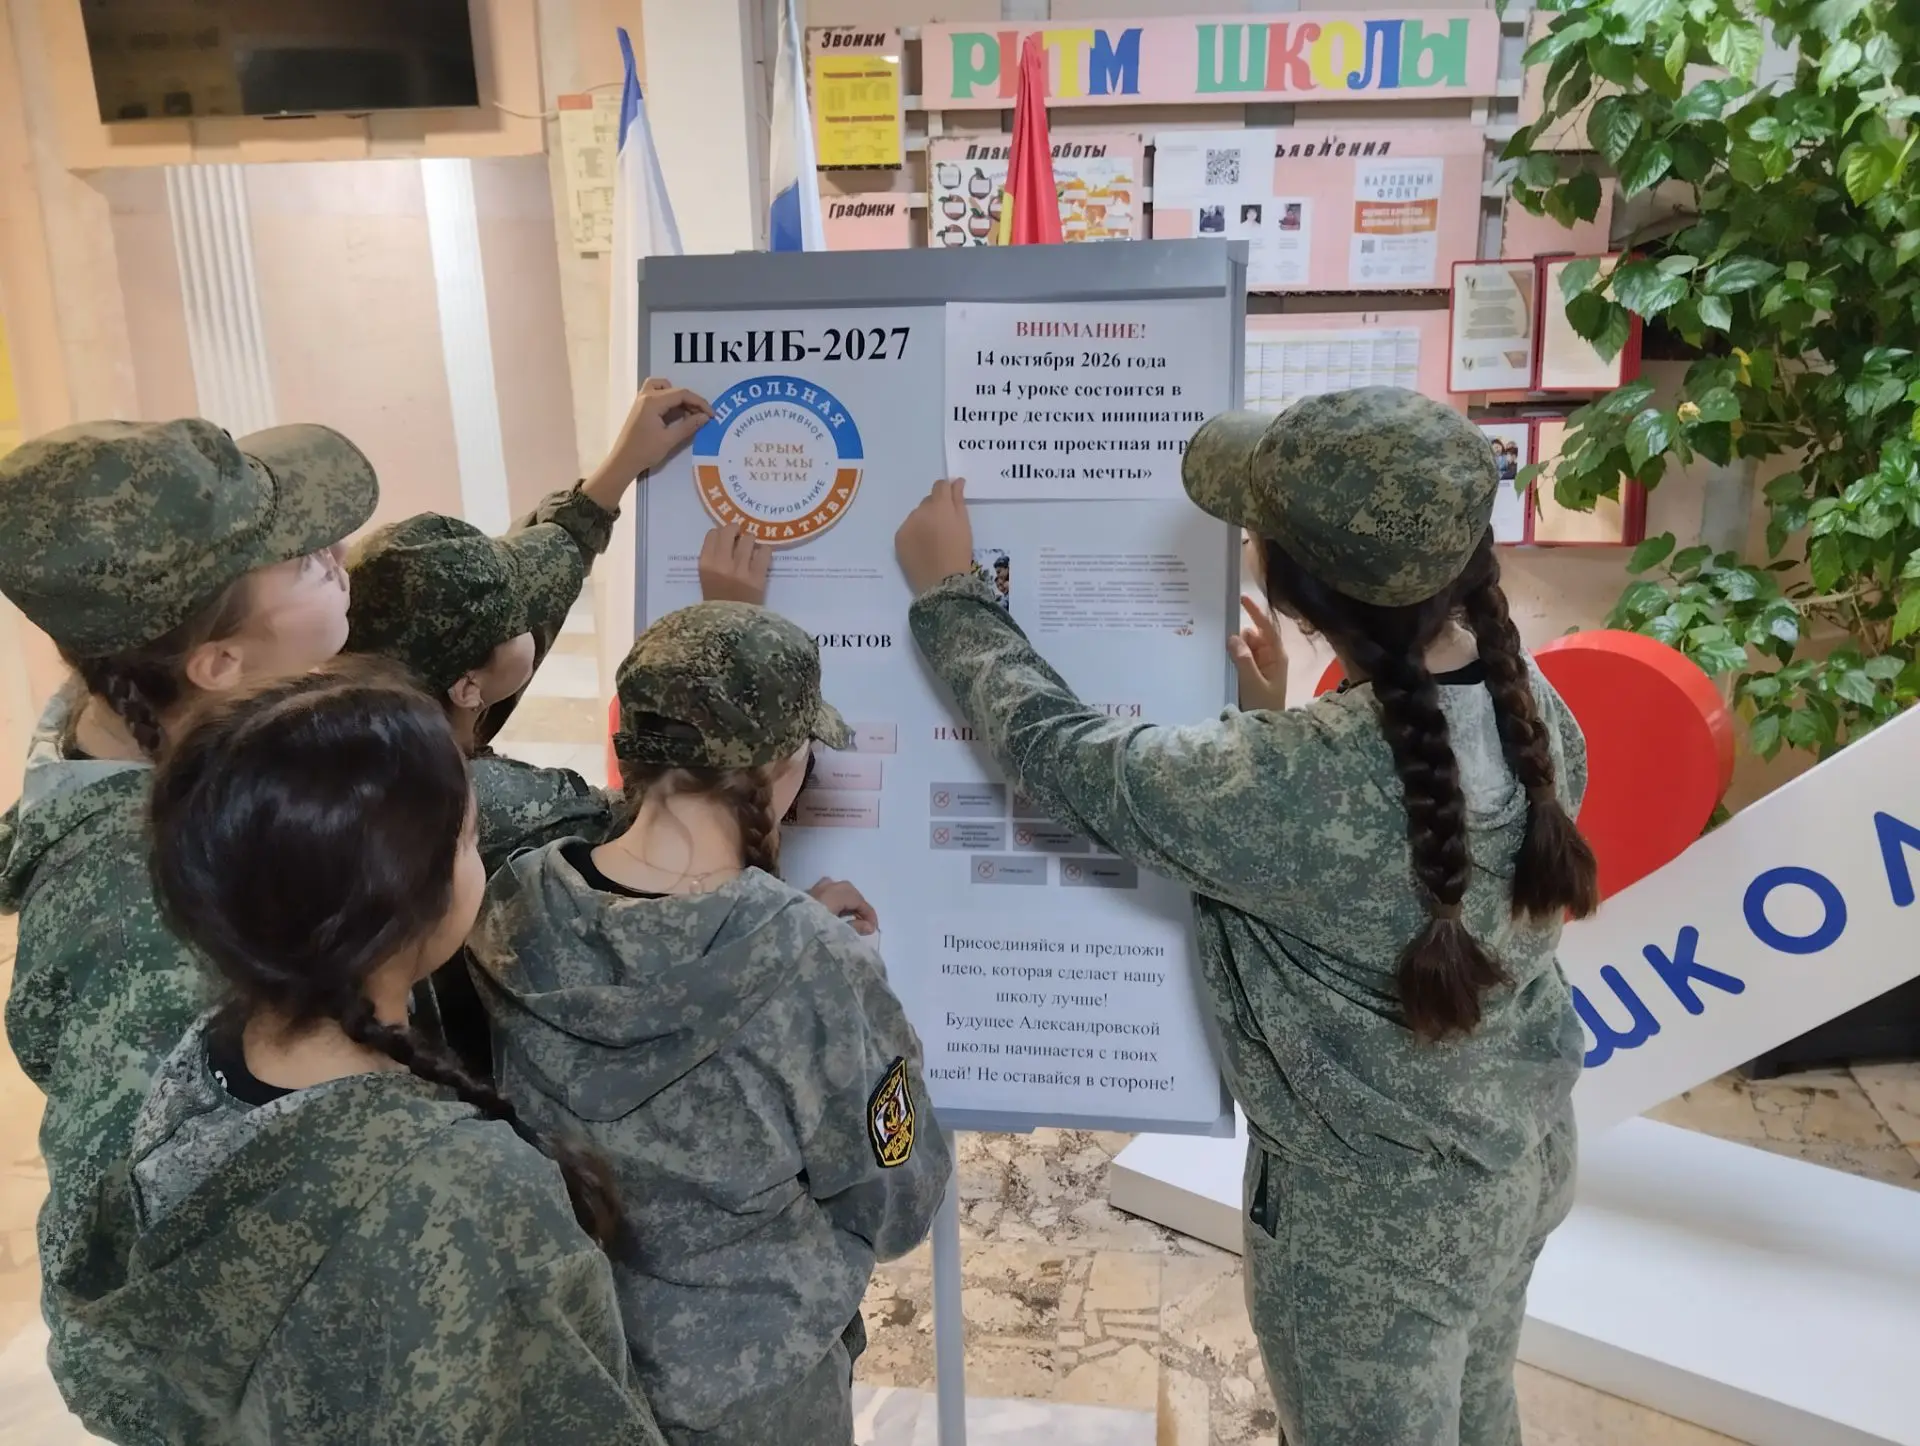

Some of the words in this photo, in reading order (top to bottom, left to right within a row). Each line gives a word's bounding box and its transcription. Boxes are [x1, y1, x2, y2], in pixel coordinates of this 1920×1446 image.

[821, 31, 886, 48] Звонки
[948, 28, 1144, 99] РИТМ
[1195, 18, 1470, 93] ШКОЛЫ
[1051, 142, 1107, 159] аботы
[1274, 138, 1392, 158] ъявления
[828, 202, 896, 219] Графики
[1016, 321, 1146, 339] ВНИМАНИЕ!
[673, 327, 910, 364] ШкИБ-2027
[976, 350, 994, 366] 14
[1000, 352, 1074, 371] октября
[1081, 352, 1121, 368] 2026
[1127, 355, 1166, 369] года
[975, 383, 996, 396] на
[1002, 381, 1012, 396] 4
[1018, 384, 1069, 400] уроке
[1074, 384, 1165, 397] состоится
[1172, 385, 1182, 396] в
[714, 381, 846, 429] ШКОЛЬНАЯ
[734, 408, 824, 441] ИНИЦИАТИВНОЕ
[953, 406, 1019, 425] Центре
[1022, 410, 1095, 424] детских
[1102, 410, 1205, 424] инициатив
[753, 443, 804, 454] КРЫМ
[958, 438, 1047, 451] состоится
[1053, 438, 1151, 454] проектная
[1158, 439, 1189, 455] игр
[744, 456, 777, 468] КАК
[786, 458, 813, 468] МЫ
[749, 472, 808, 482] ХОТИМ
[1000, 464, 1075, 480] «Школа
[1082, 467, 1152, 480] мечты»
[728, 474, 826, 515] БЮДЖЕТИРОВАНИЕ
[708, 486, 849, 537] ИНИЦИАТИВА
[815, 634, 892, 648] ОЕКТОВ
[943, 934, 1065, 953] Присоединяйся
[1071, 943, 1080, 953] и
[1085, 943, 1165, 957] предложи
[941, 963, 987, 977] идею,
[992, 964, 1053, 981] которая
[1058, 967, 1118, 981] сделает
[1123, 971, 1165, 986] нашу
[996, 991, 1047, 1007] школу
[1051, 993, 1108, 1009] лучше!
[946, 1012, 1015, 1030] Будущее
[1019, 1015, 1161, 1036] Александровской
[947, 1041, 1000, 1054] школы
[1005, 1044, 1094, 1059] начинается
[1099, 1050, 1107, 1059] с
[1113, 1050, 1158, 1062] твоих
[930, 1066, 972, 1081] идей!
[977, 1067, 999, 1082] Не
[1003, 1071, 1081, 1086] оставайся
[1086, 1076, 1095, 1086] в
[1099, 1075, 1175, 1093] стороне!
